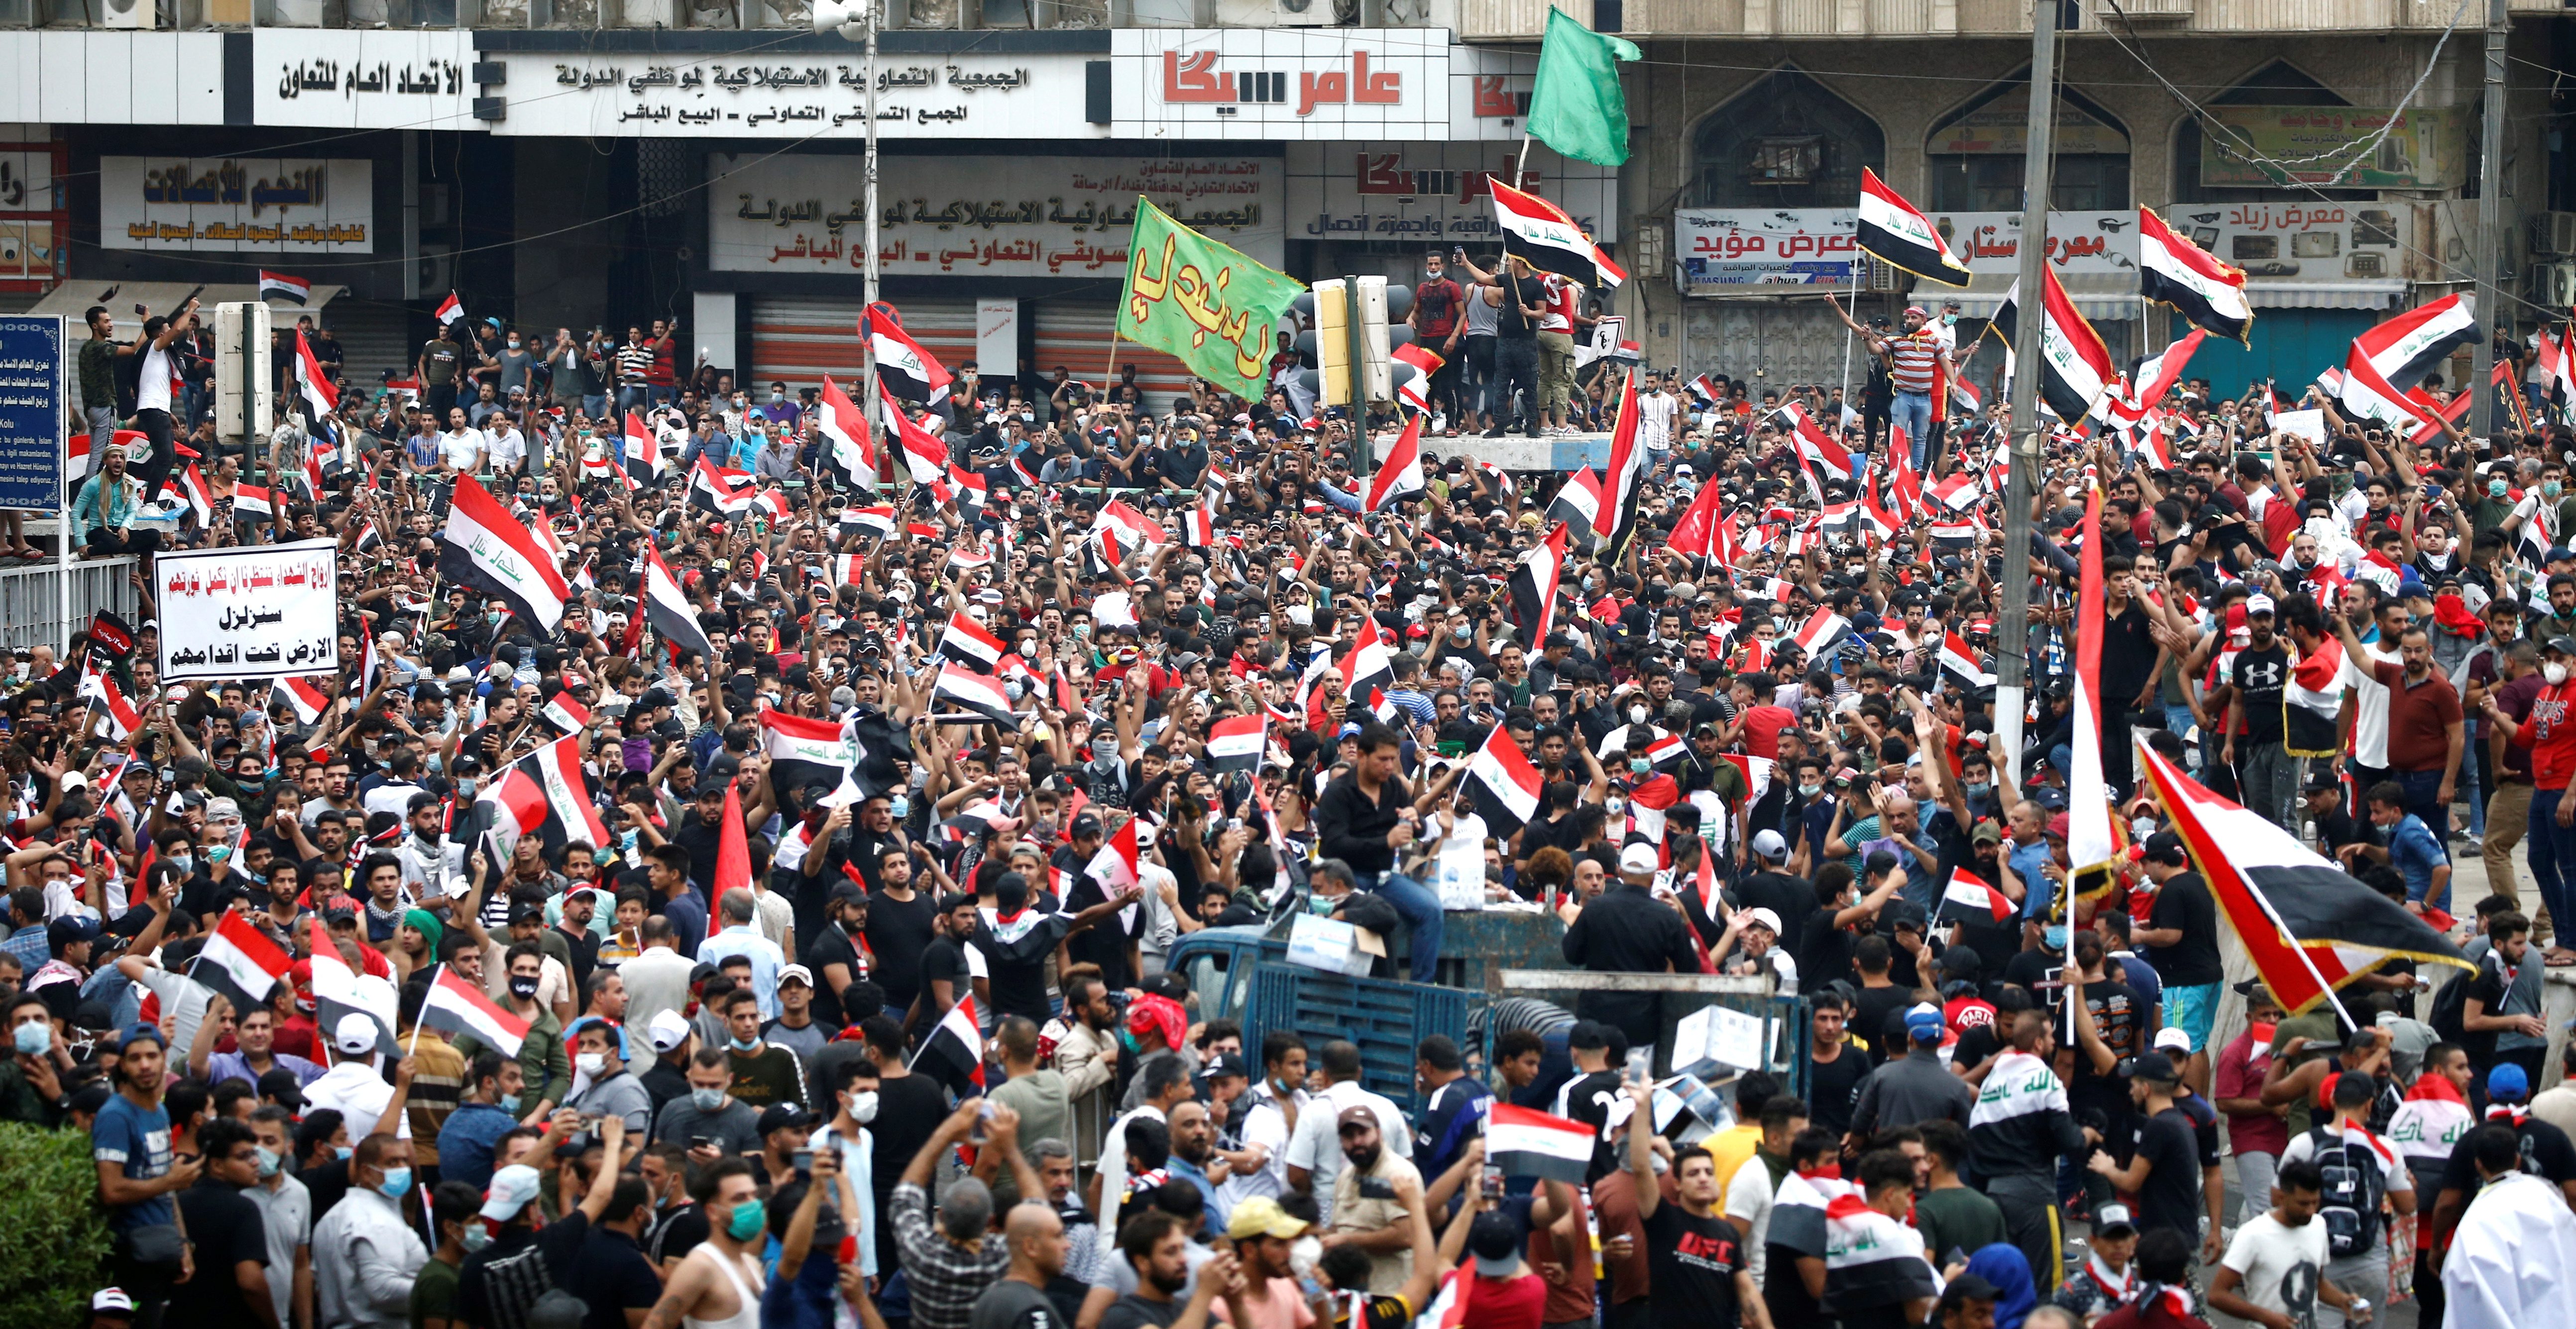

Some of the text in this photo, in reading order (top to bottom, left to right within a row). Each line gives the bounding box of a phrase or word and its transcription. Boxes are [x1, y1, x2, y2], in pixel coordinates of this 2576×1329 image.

[279, 57, 338, 100] للتعاون
[346, 61, 390, 101] العام
[556, 64, 622, 90] الدولة
[628, 65, 702, 95] لموظفي
[713, 65, 828, 91] الاستهلاكية
[945, 65, 1028, 93] الجمعية
[1297, 49, 1402, 117] عامر
[618, 103, 671, 123] المباشر
[678, 107, 721, 125] البيع
[747, 105, 825, 127] التعاوني
[917, 105, 968, 126] المجمع
[1139, 160, 1183, 177] للتعاون
[1185, 163, 1215, 178] العام
[251, 164, 324, 219] النجم
[738, 193, 820, 228] الدولة
[826, 198, 906, 236] لموفي
[1307, 213, 1369, 236] اتصال
[1375, 213, 1443, 237] واجهزة
[2230, 204, 2345, 231] معرض زياد
[768, 233, 843, 265] المباشر
[939, 238, 1041, 273] التعاوني
[1693, 227, 1765, 259] مؤيد
[1959, 225, 2017, 266] ستار
[205, 563, 227, 597] نكمل
[277, 560, 308, 587] الشهداء
[219, 604, 283, 631] سنزلزل
[170, 637, 333, 673] الارض تحت اقدامهم
[1677, 1231, 1735, 1265] UFC
